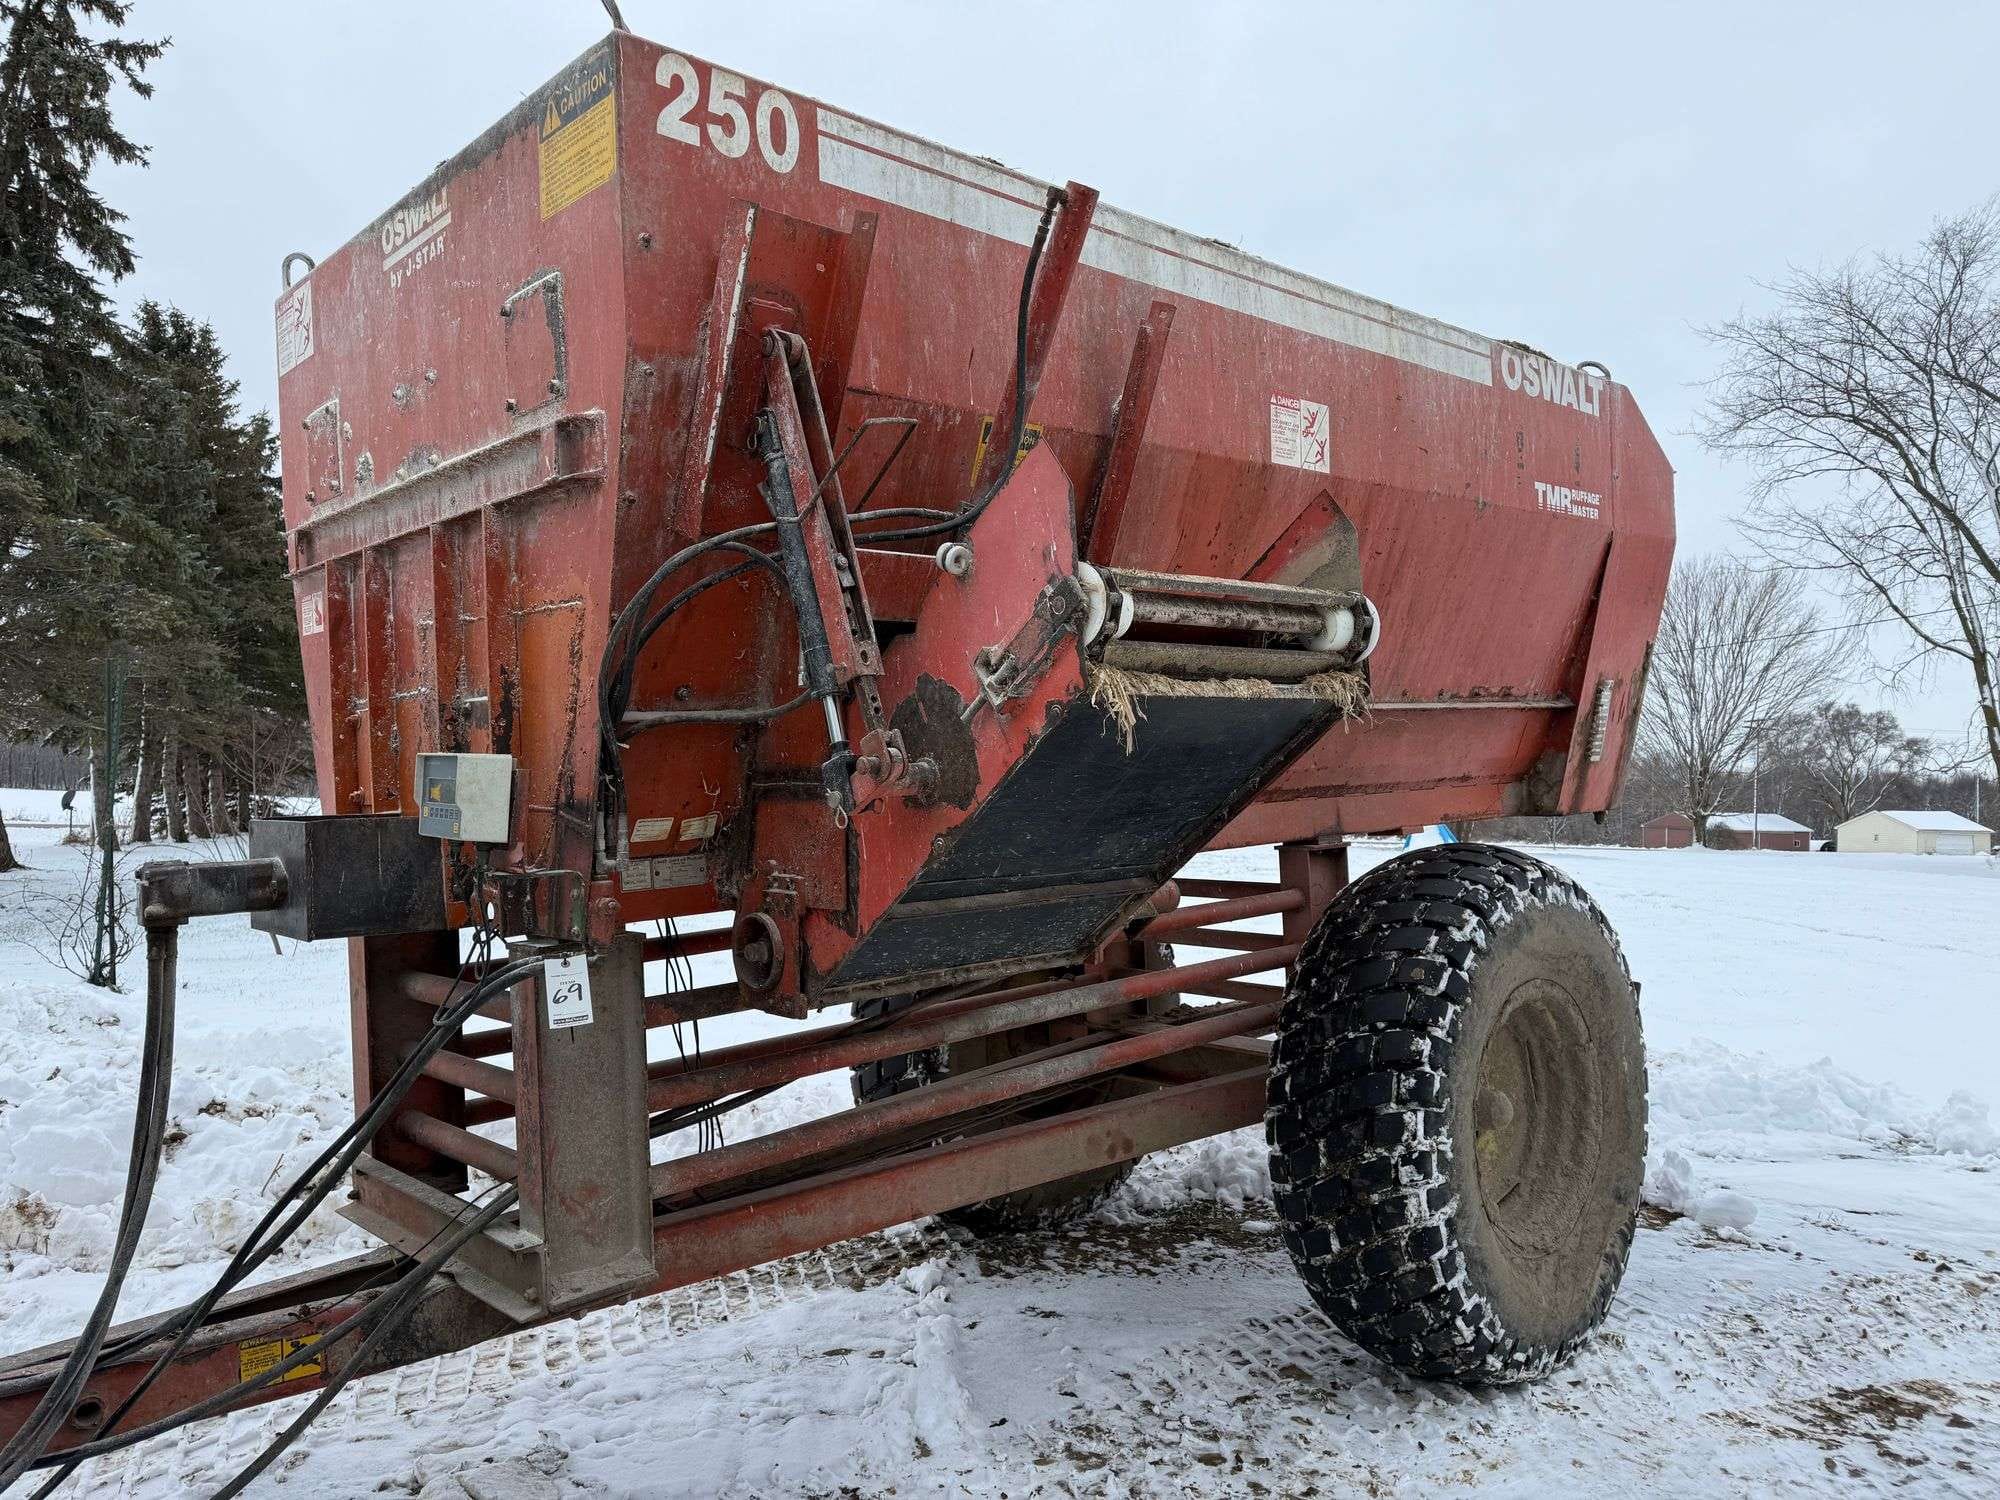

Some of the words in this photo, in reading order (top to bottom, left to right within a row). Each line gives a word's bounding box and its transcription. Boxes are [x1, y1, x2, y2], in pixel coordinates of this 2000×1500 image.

[560, 68, 607, 115] CAUTION
[655, 53, 799, 173] 250
[390, 270, 402, 289] by
[1502, 349, 1603, 417] OSWALT
[1534, 481, 1573, 515] TMR
[1571, 504, 1599, 520] MASTER
[552, 982, 583, 1005] 69
